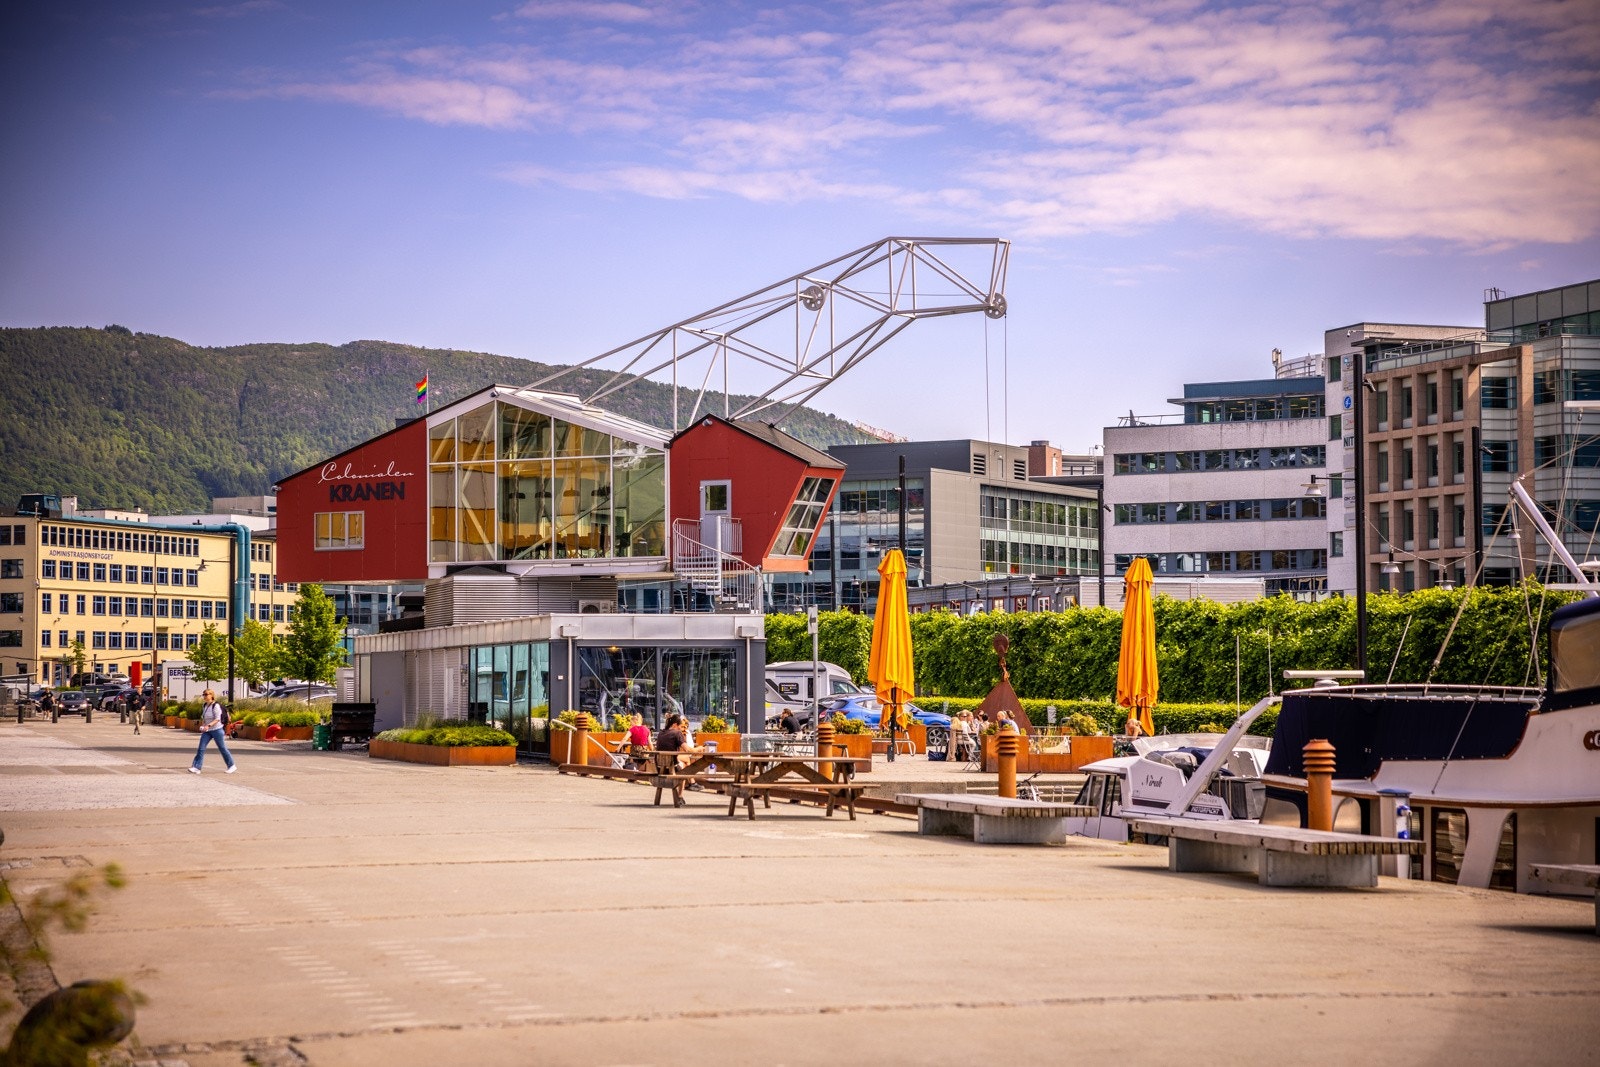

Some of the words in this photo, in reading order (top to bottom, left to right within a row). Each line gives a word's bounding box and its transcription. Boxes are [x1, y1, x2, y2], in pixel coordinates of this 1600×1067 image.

[318, 461, 414, 484] Colonialen
[330, 481, 405, 502] KRANEN
[49, 549, 114, 560] ADMINISTRASJONSBYGGET
